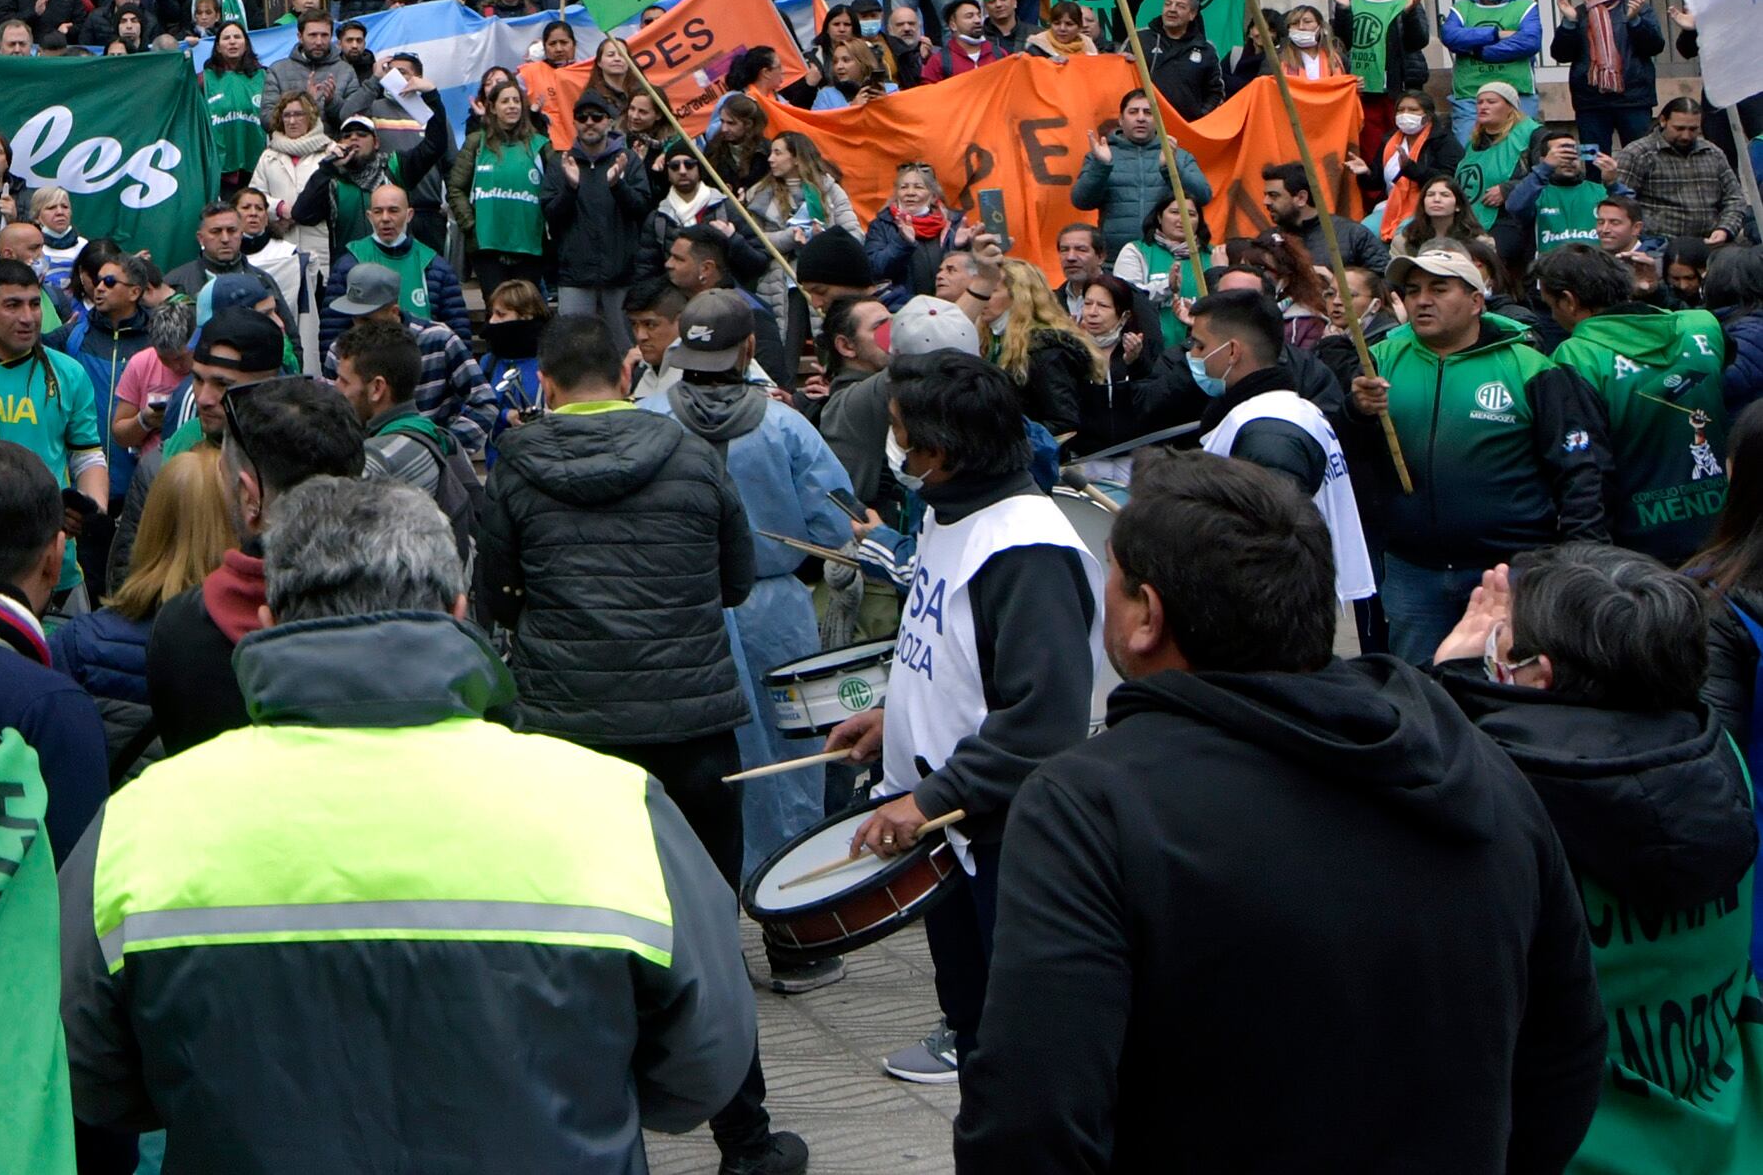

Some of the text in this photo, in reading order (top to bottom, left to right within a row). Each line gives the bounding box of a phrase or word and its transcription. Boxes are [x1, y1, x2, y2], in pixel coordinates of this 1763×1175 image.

[474, 186, 539, 204] Judiciales
[1469, 410, 1517, 424] MENDOZA
[839, 679, 871, 710] ATE
